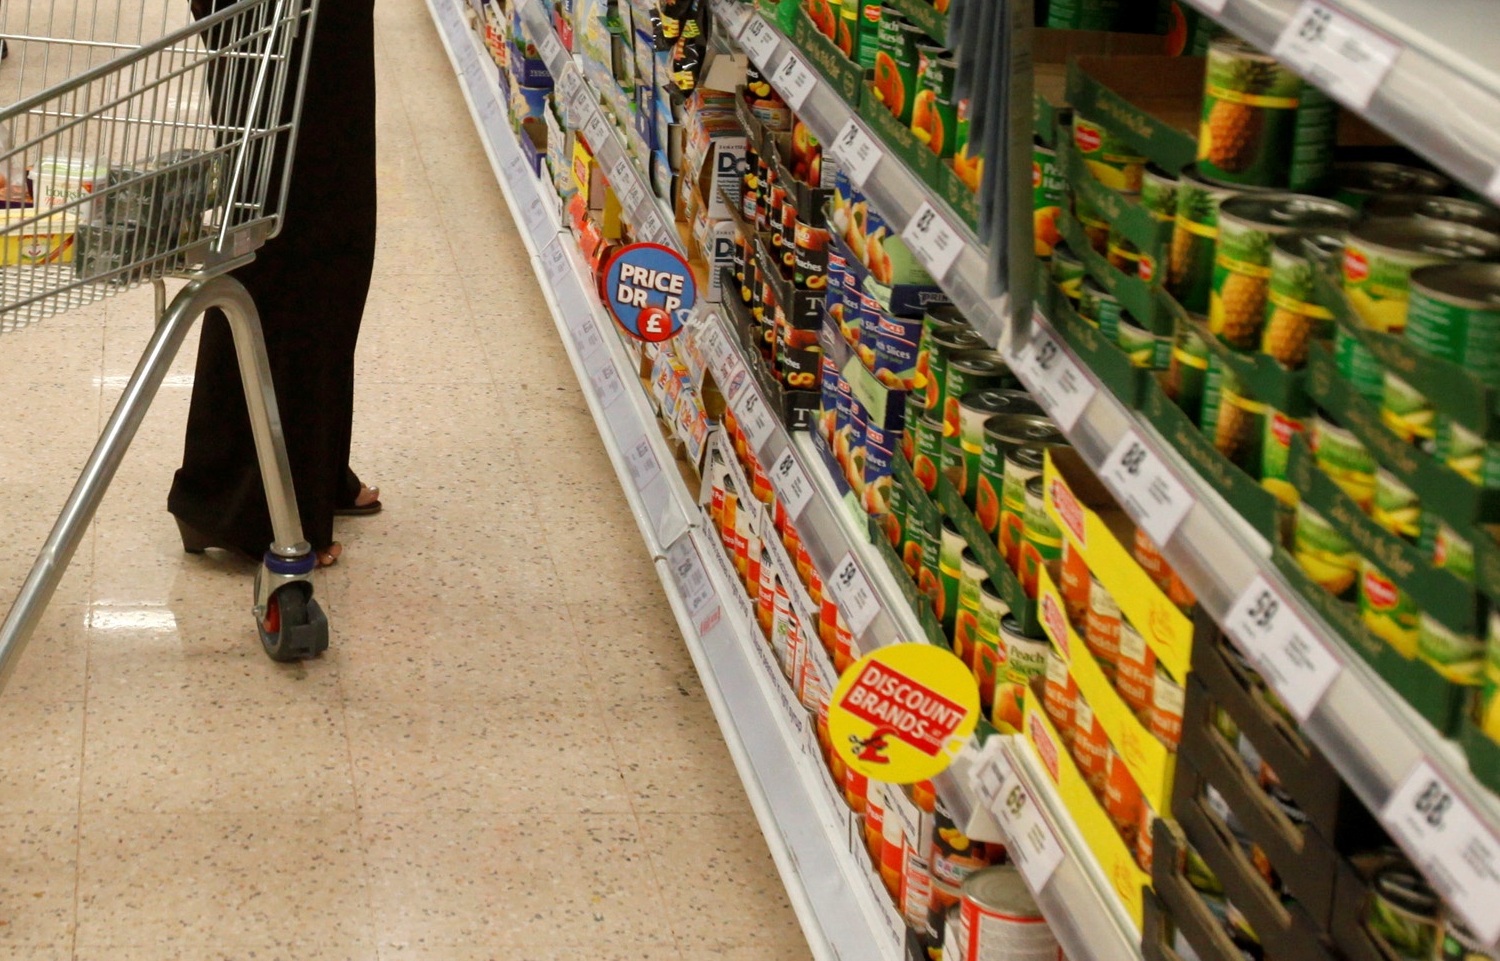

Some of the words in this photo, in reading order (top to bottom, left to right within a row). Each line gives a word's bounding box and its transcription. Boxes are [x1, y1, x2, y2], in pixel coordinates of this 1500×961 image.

[619, 263, 685, 296] PRICE
[646, 313, 662, 333] £
[884, 343, 911, 361] Slices
[1010, 646, 1046, 664] Peach
[861, 666, 963, 730] DISCOUNT
[847, 685, 929, 739] BRANDS
